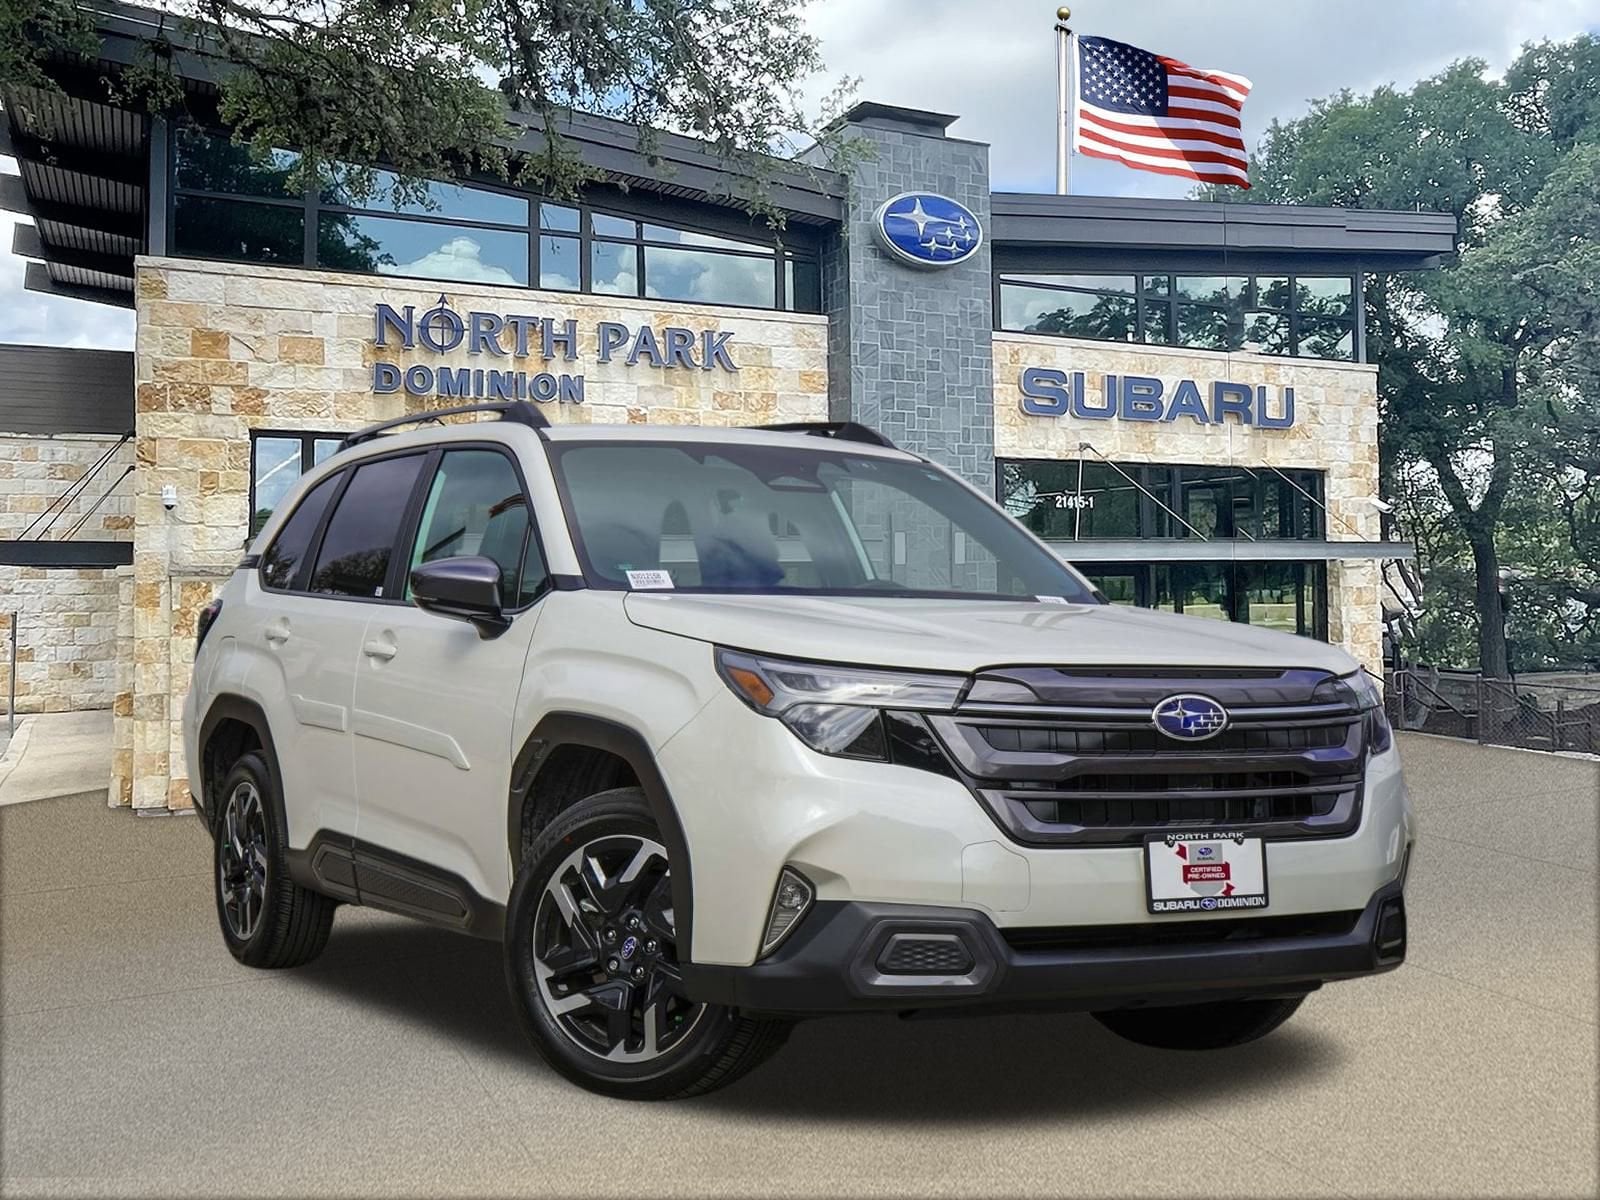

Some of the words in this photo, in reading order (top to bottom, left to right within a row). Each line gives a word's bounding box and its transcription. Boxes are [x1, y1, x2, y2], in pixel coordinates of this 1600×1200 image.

[374, 302, 579, 361] NORTH
[598, 320, 741, 372] PARK
[373, 362, 585, 403] DOMINION
[1018, 367, 1295, 429] SUBARU
[1055, 495, 1094, 509] 21415-1
[1153, 900, 1200, 911] SUBARU
[1217, 896, 1265, 908] DOMINION
